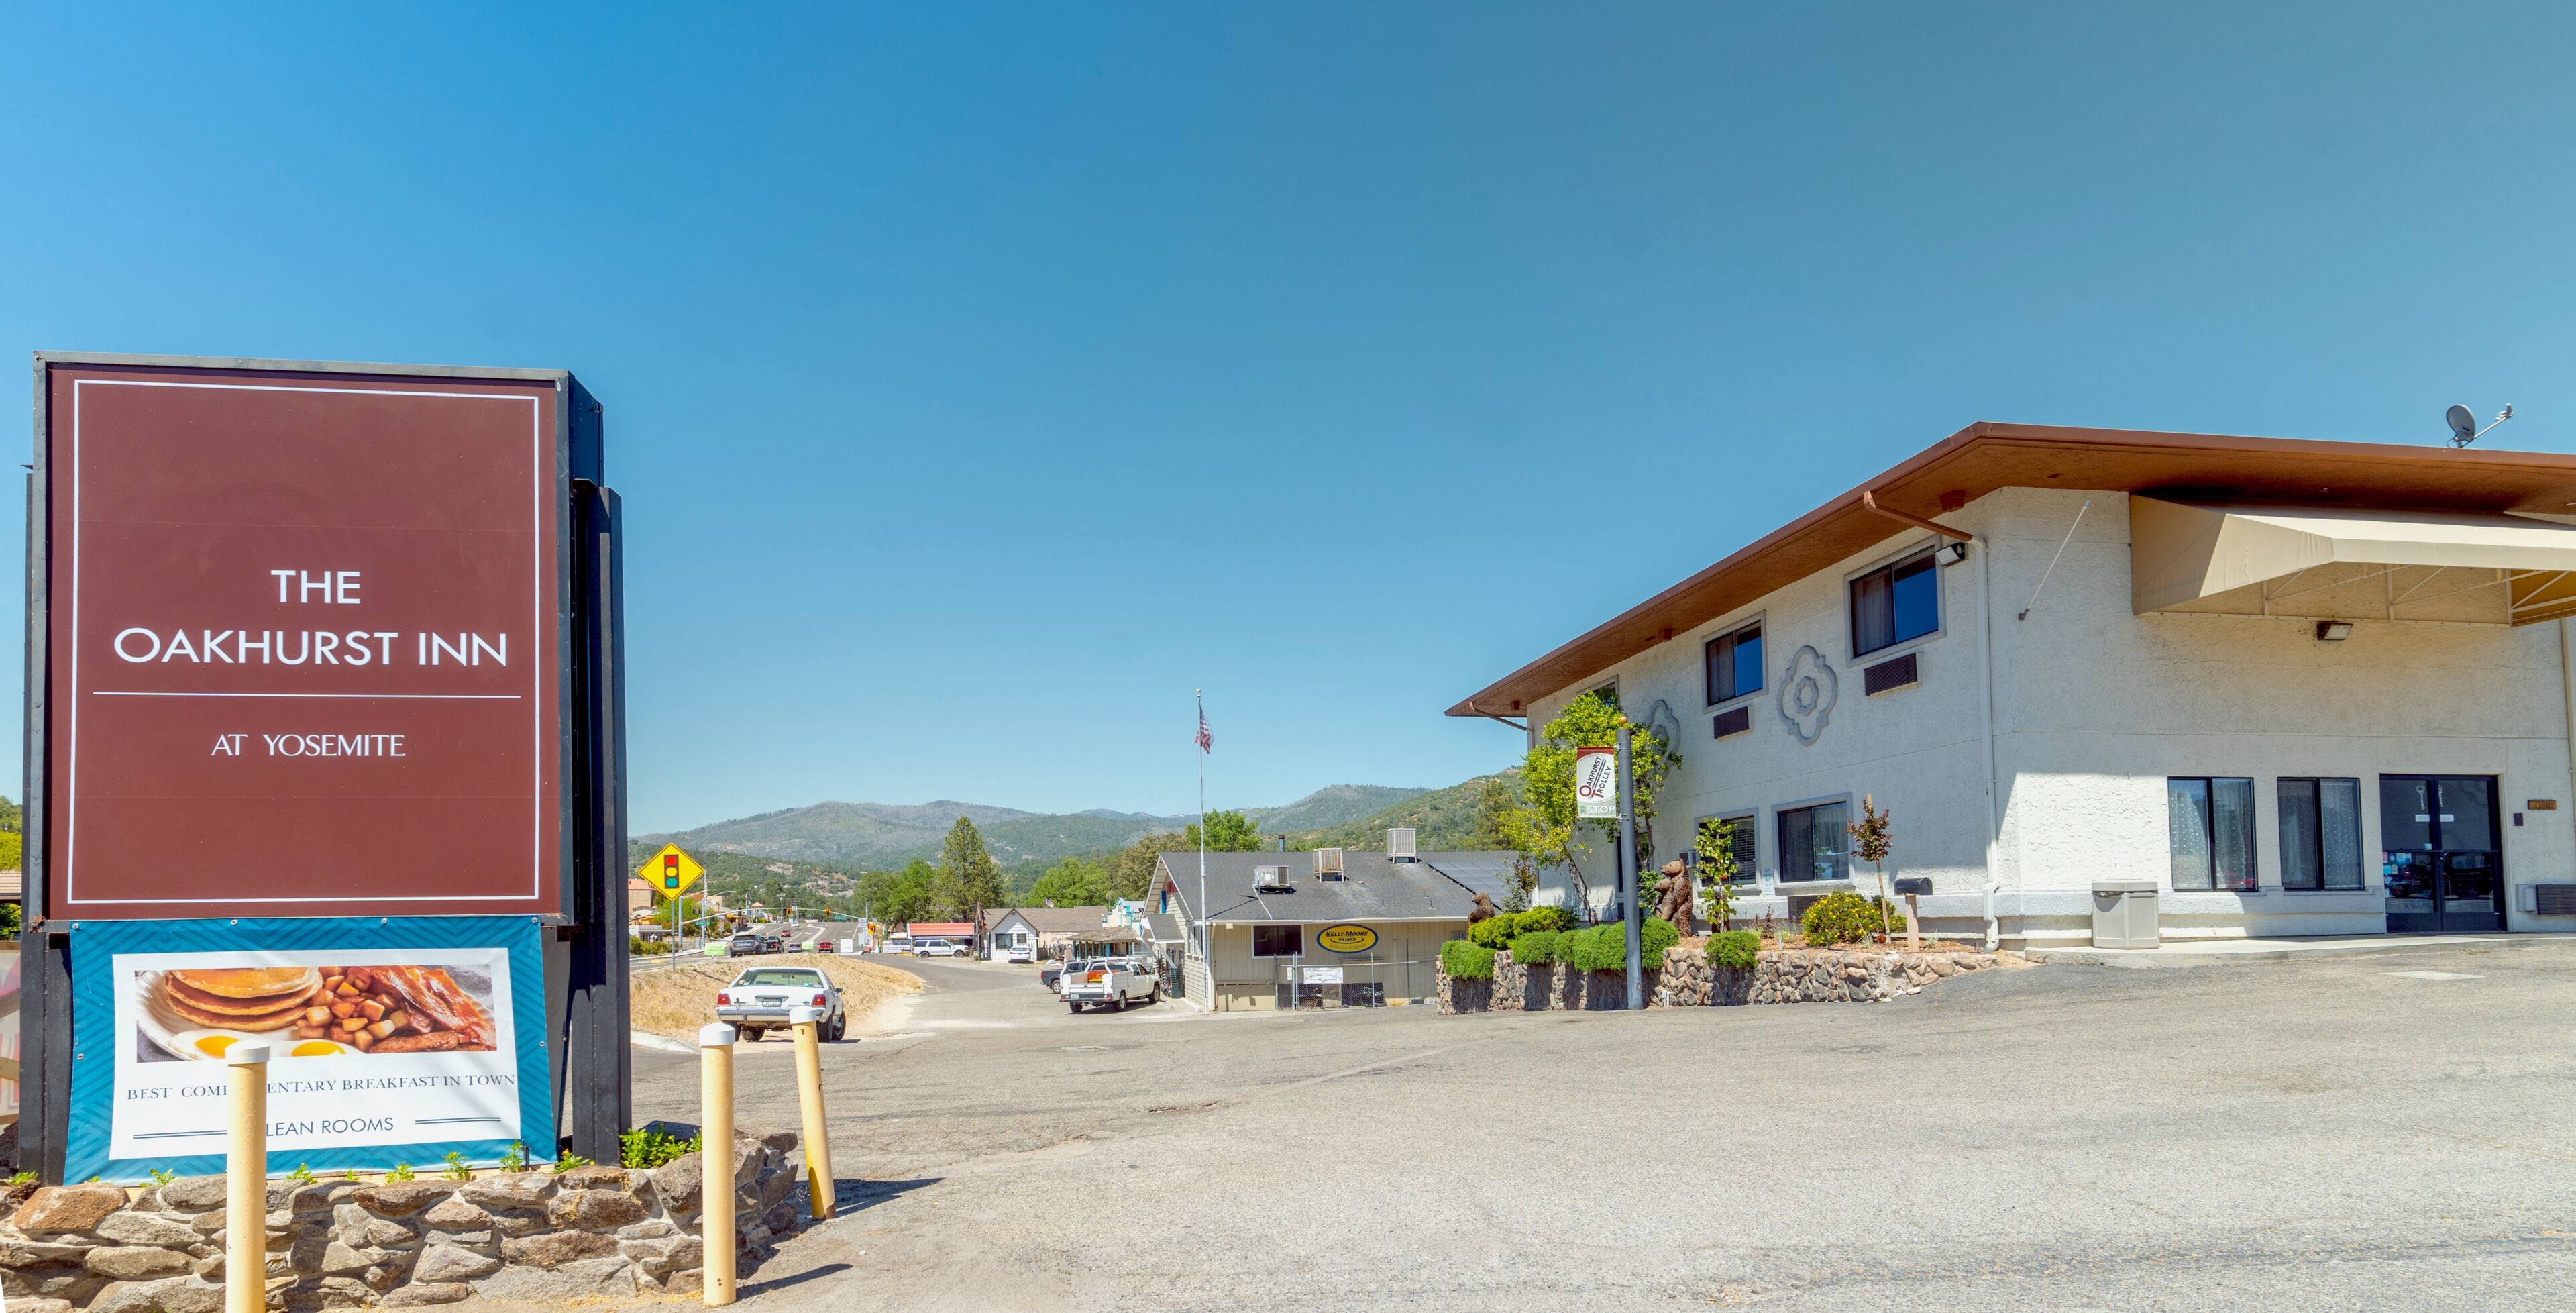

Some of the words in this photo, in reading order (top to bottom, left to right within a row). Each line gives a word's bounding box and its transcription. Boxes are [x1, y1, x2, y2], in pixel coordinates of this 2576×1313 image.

[270, 570, 360, 604] THE
[114, 627, 398, 666] OAKHURST
[419, 632, 506, 667] INN
[211, 734, 248, 756] AT
[262, 734, 406, 757] YOSEMITE
[1579, 756, 1601, 797] OAKHURST
[1591, 766, 1611, 798] TROLLEY
[1587, 806, 1615, 814] STOP
[127, 1087, 172, 1100] BEST
[342, 1076, 439, 1090] BREAKFAST
[444, 1075, 460, 1086] IN
[465, 1075, 515, 1086] TOWN
[266, 1121, 314, 1137] LEAN
[322, 1117, 394, 1133] ROOMS
